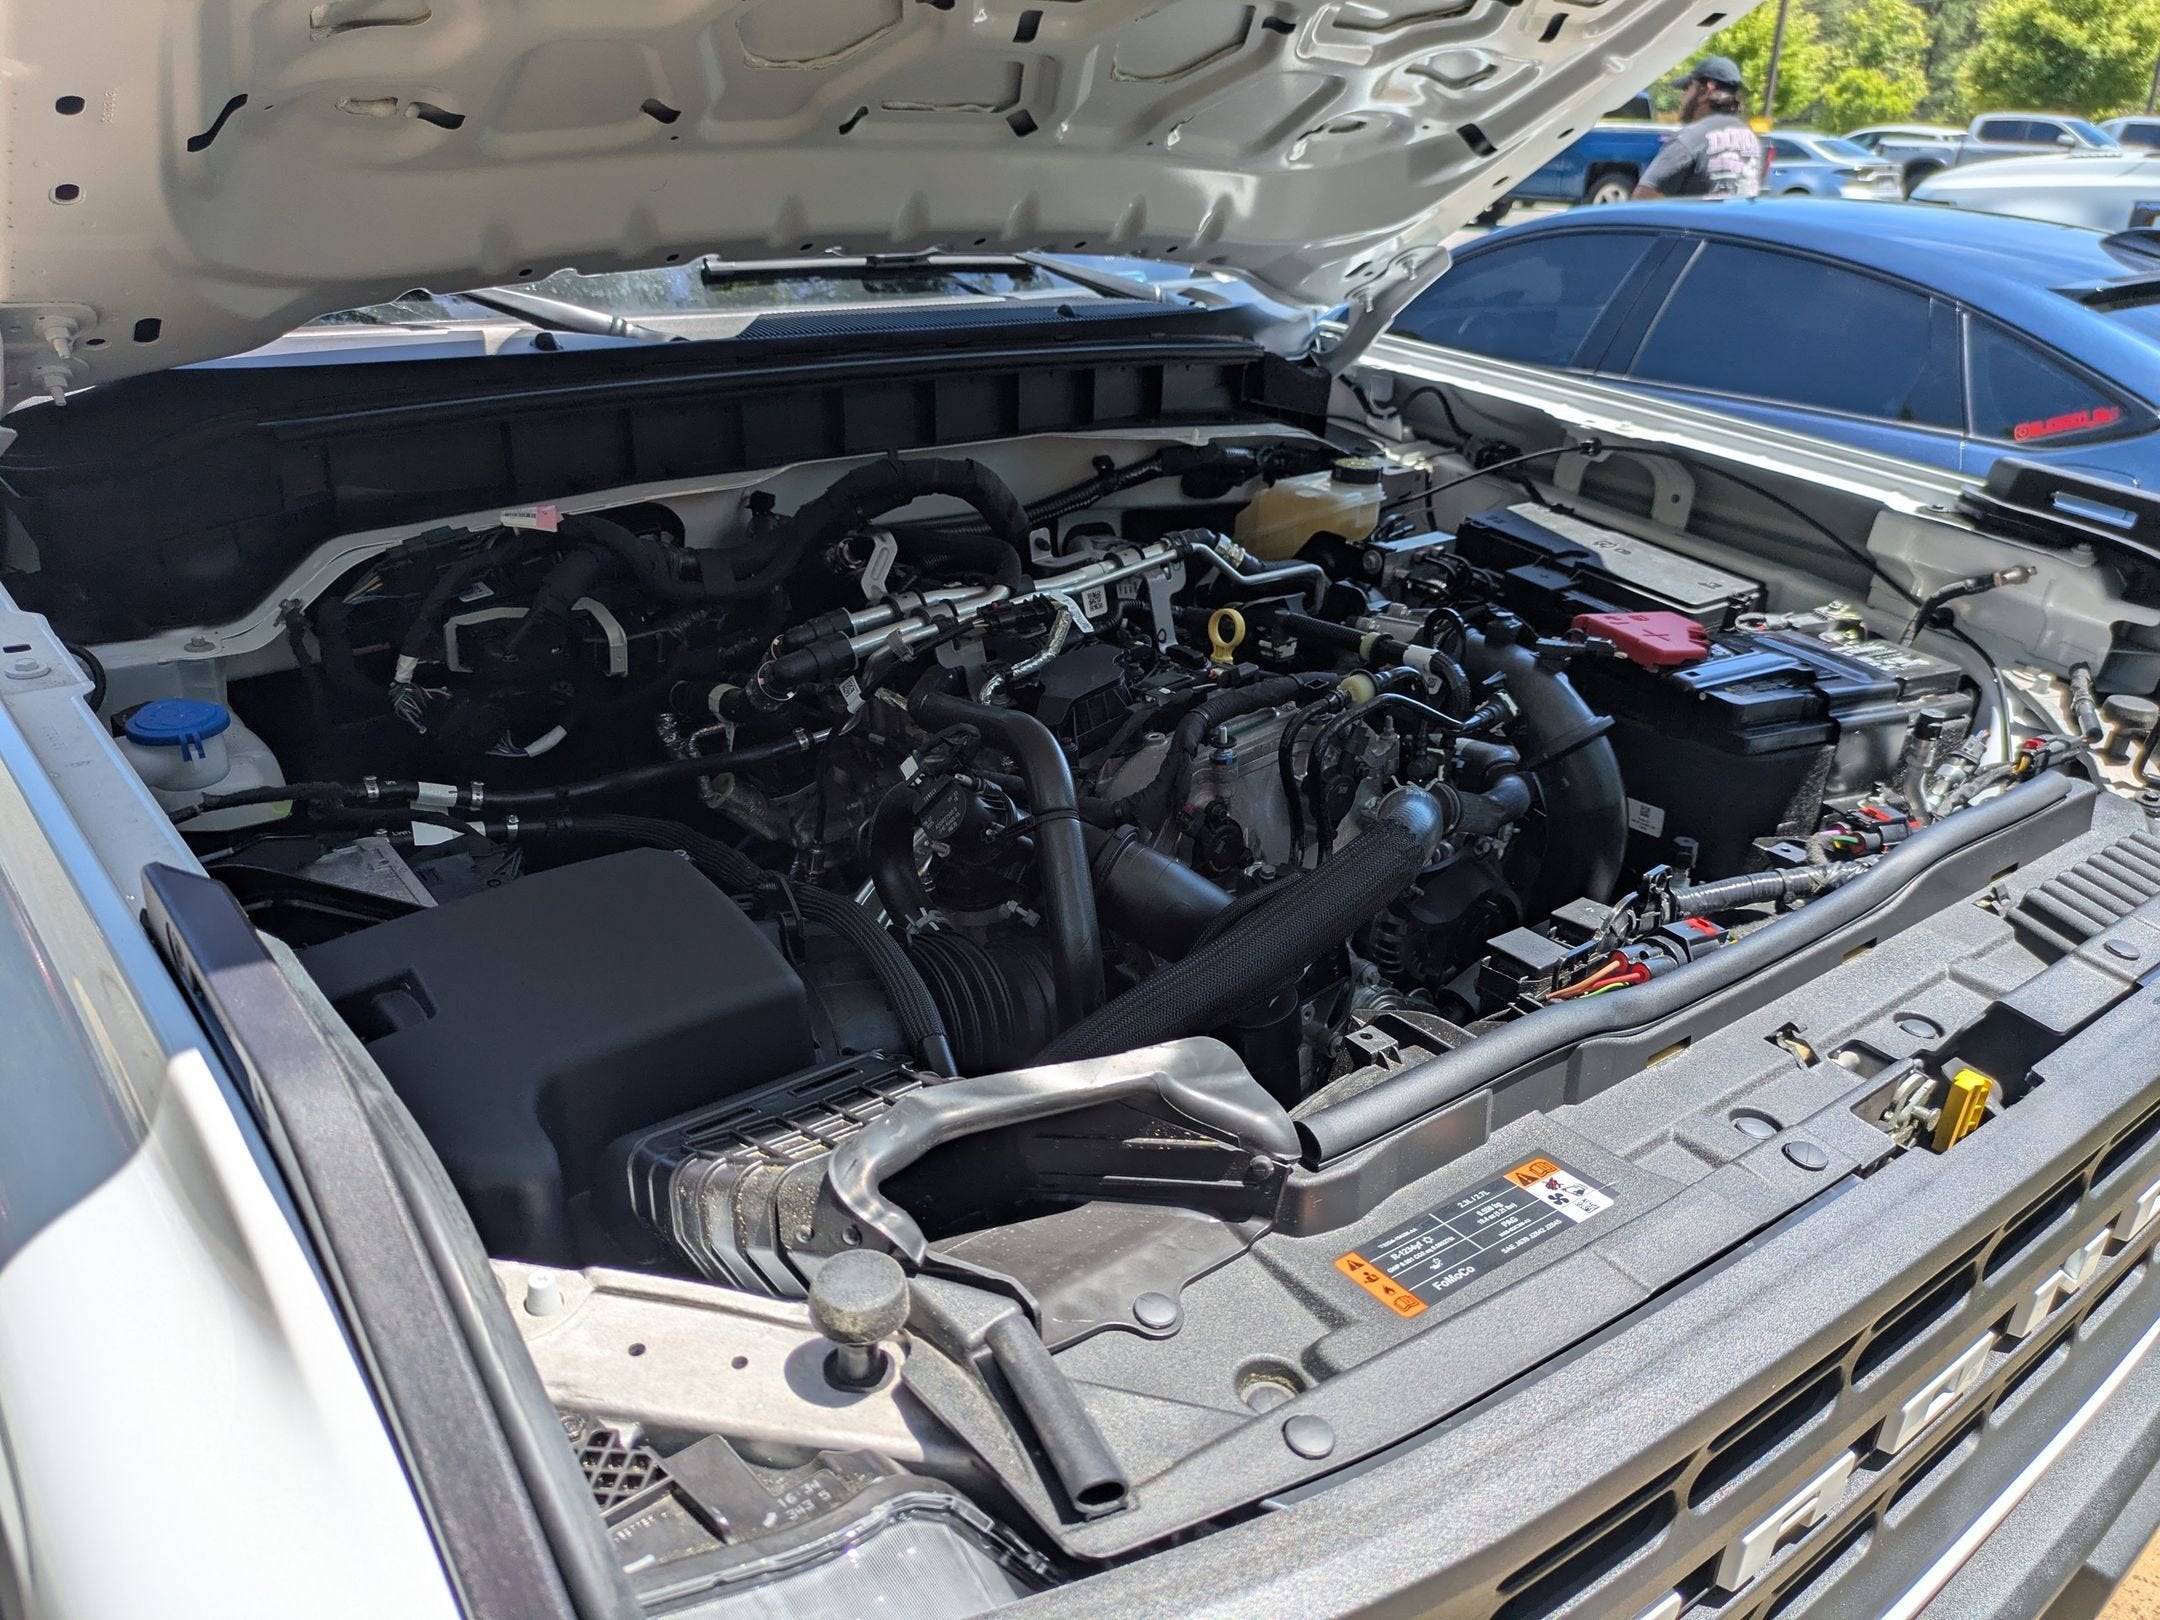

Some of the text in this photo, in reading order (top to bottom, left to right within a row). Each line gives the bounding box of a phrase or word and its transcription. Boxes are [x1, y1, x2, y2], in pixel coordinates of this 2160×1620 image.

[1457, 1197, 1473, 1208] 2.3L
[1474, 1190, 1491, 1201] 2.7L
[1500, 1216, 1519, 1227] PAG
[1390, 1241, 1423, 1260] R-1234yf
[1501, 1243, 1516, 1254] SAE
[1432, 1266, 1476, 1290] FoMoCo
